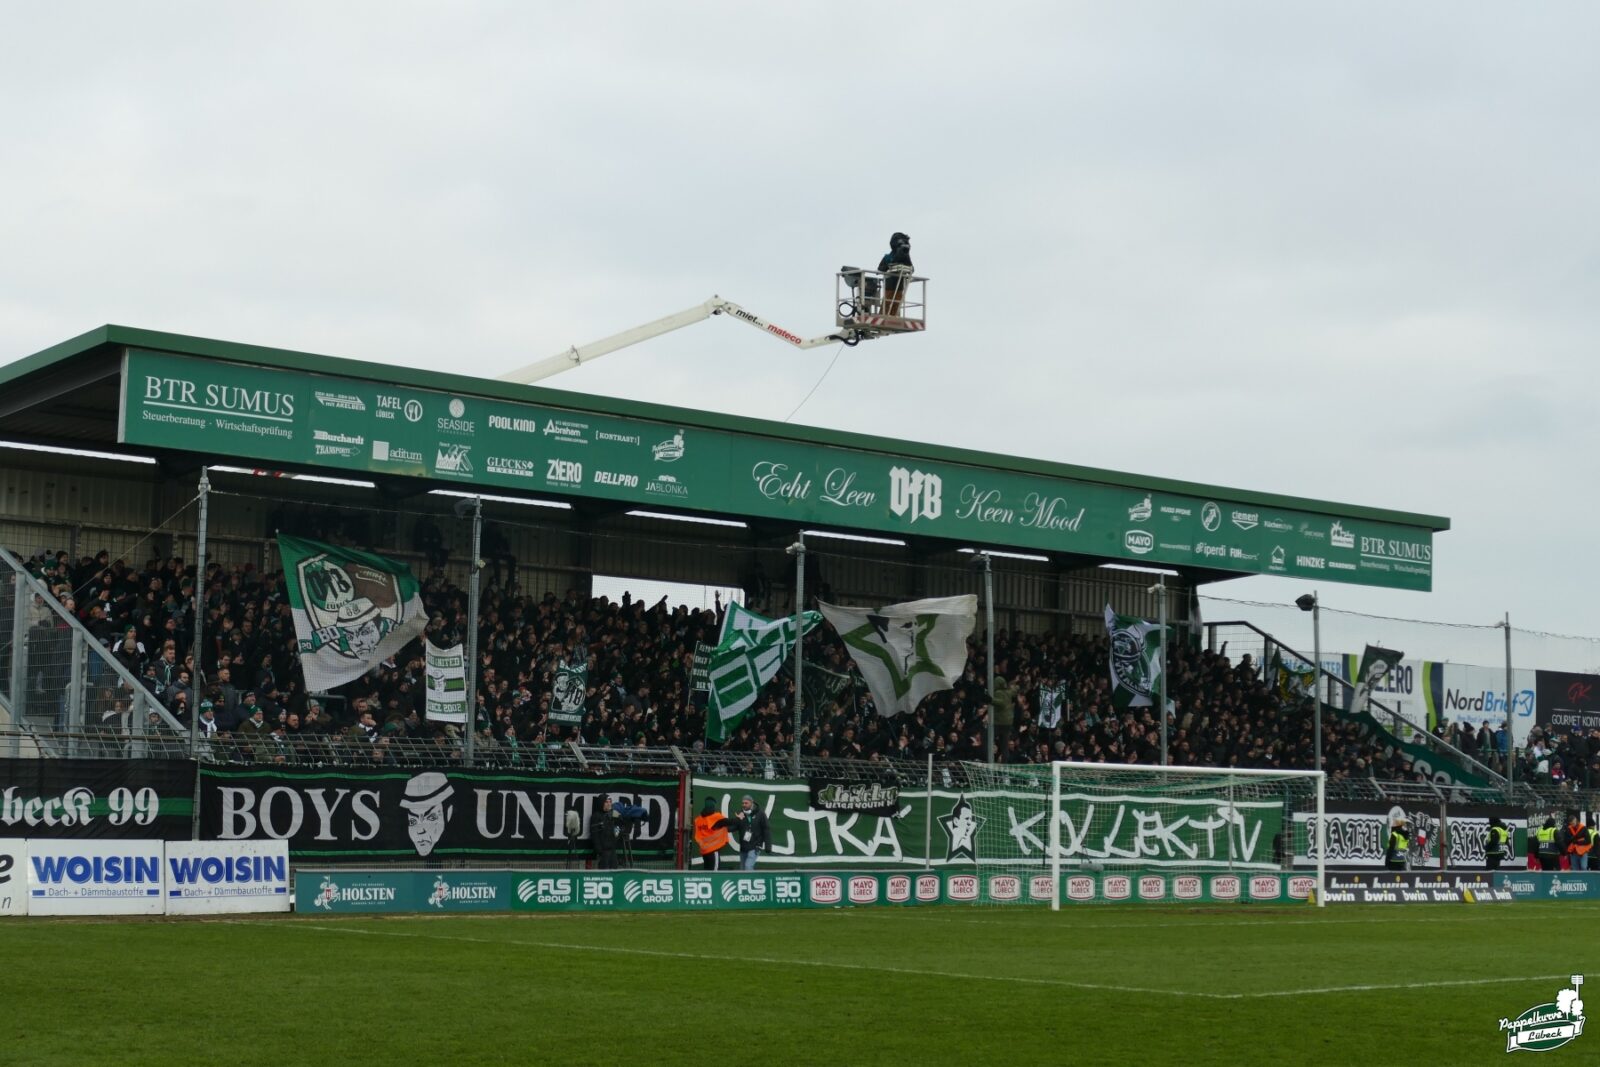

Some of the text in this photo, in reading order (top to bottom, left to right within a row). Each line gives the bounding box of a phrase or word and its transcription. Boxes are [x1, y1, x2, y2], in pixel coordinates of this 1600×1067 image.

[767, 324, 802, 345] mateco
[144, 376, 294, 416] BTR SUMUS
[377, 395, 402, 410] TAFEL
[376, 410, 395, 419] LÜBECK
[142, 410, 293, 440] Steuerberatung Wirtschaftsprüfung
[437, 417, 475, 433] SEASIDE
[543, 419, 581, 437] Abraham
[321, 431, 364, 445] Burchardt
[389, 448, 423, 461] aditum
[487, 456, 527, 470] GLÜCKS
[594, 470, 639, 488] DELLPRO
[752, 461, 876, 507] Echt Leev
[645, 482, 688, 495] JABLONKA
[955, 483, 1085, 533] Keen Mood
[1232, 510, 1259, 522] clement
[1128, 535, 1151, 546] MAYO
[1203, 543, 1226, 557] iperdi
[1360, 536, 1385, 555] BTR
[1388, 540, 1431, 560] SUMUS
[1296, 555, 1325, 569] HINZKE
[1551, 714, 1600, 727] GOURMET KONT
[108, 787, 159, 826] 99
[216, 785, 380, 841] BOYS
[31, 856, 159, 884] WOISIN
[169, 856, 286, 885] WOISIN
[537, 879, 571, 895] FLS
[642, 879, 674, 895] FLS
[738, 879, 766, 895] FLS
[815, 880, 837, 888] MAYO
[853, 880, 873, 888] MAYO
[890, 880, 907, 888] MAYO
[920, 880, 936, 888] MAYO
[953, 879, 975, 888] MAYO
[994, 879, 1016, 888] MAYO
[1071, 880, 1090, 888] MAYO
[1108, 879, 1127, 888] MAYO
[1142, 879, 1160, 887] MAYO
[1178, 879, 1198, 887] MAYO
[1215, 879, 1234, 887] MAYO
[1254, 879, 1276, 887] MAYO
[1293, 879, 1314, 888] MAYO
[1512, 883, 1535, 892] HOLSTEN
[1562, 883, 1587, 892] HOLSTEN
[48, 888, 71, 897] Dach-
[82, 888, 144, 897] Dämmbaustoffe
[184, 887, 207, 897] Dach-
[214, 886, 273, 896] Dämmbaustoffe
[342, 887, 396, 901] HOLSTEN
[452, 886, 497, 900] HOLSTEN
[583, 882, 613, 898] 30
[684, 882, 713, 898] 30
[775, 881, 801, 897] 30
[815, 888, 837, 896] LÜBECK
[853, 888, 872, 896] LÜBECK
[890, 888, 906, 896] LÜBECK
[953, 886, 974, 894] LÜBECK
[537, 895, 571, 903] GROUP
[642, 895, 674, 903] GROUP
[738, 894, 766, 902] GROUP
[1324, 890, 1355, 901] bwin
[1364, 890, 1397, 901] bwin
[1402, 890, 1428, 901] bwin
[1433, 890, 1459, 901] bwin
